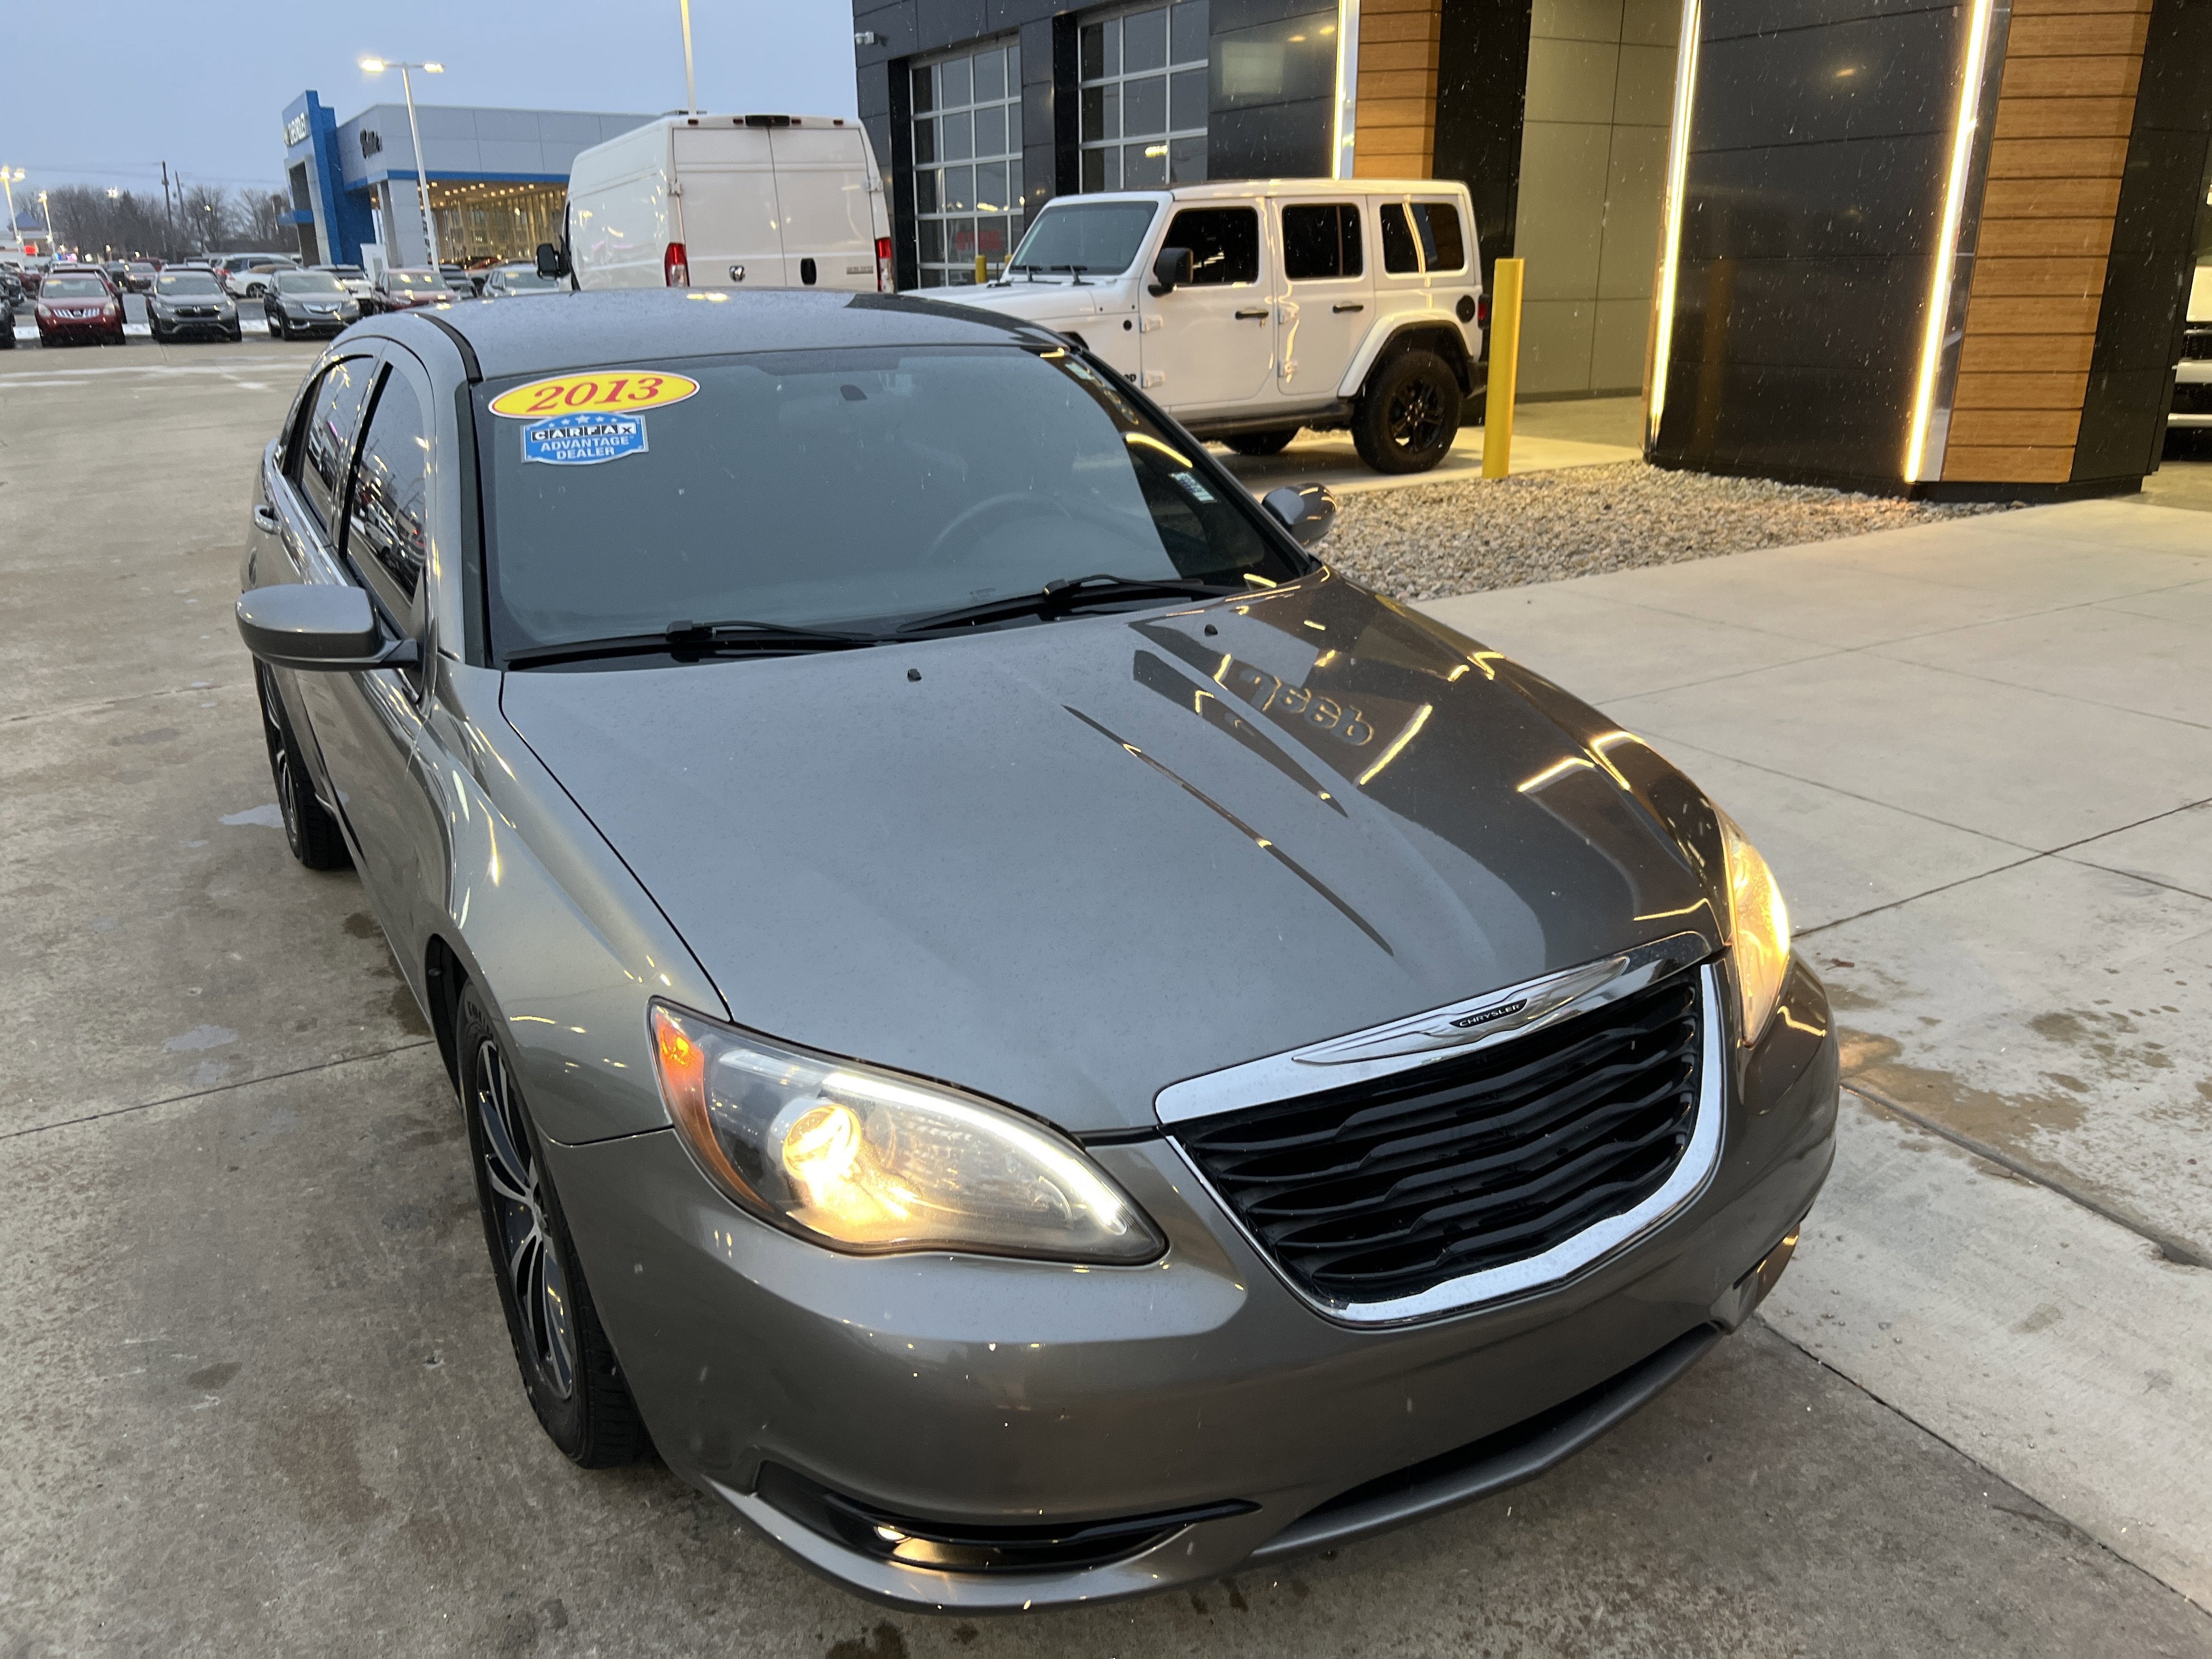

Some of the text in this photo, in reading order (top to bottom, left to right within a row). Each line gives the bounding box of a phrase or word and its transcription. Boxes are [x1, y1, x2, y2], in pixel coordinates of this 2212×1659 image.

[526, 377, 664, 413] 2013
[534, 425, 633, 441] CARFAX
[540, 435, 630, 453] ADVANTAGE
[556, 447, 615, 460] DEALER
[1459, 1004, 1520, 1027] CHRYSLER
